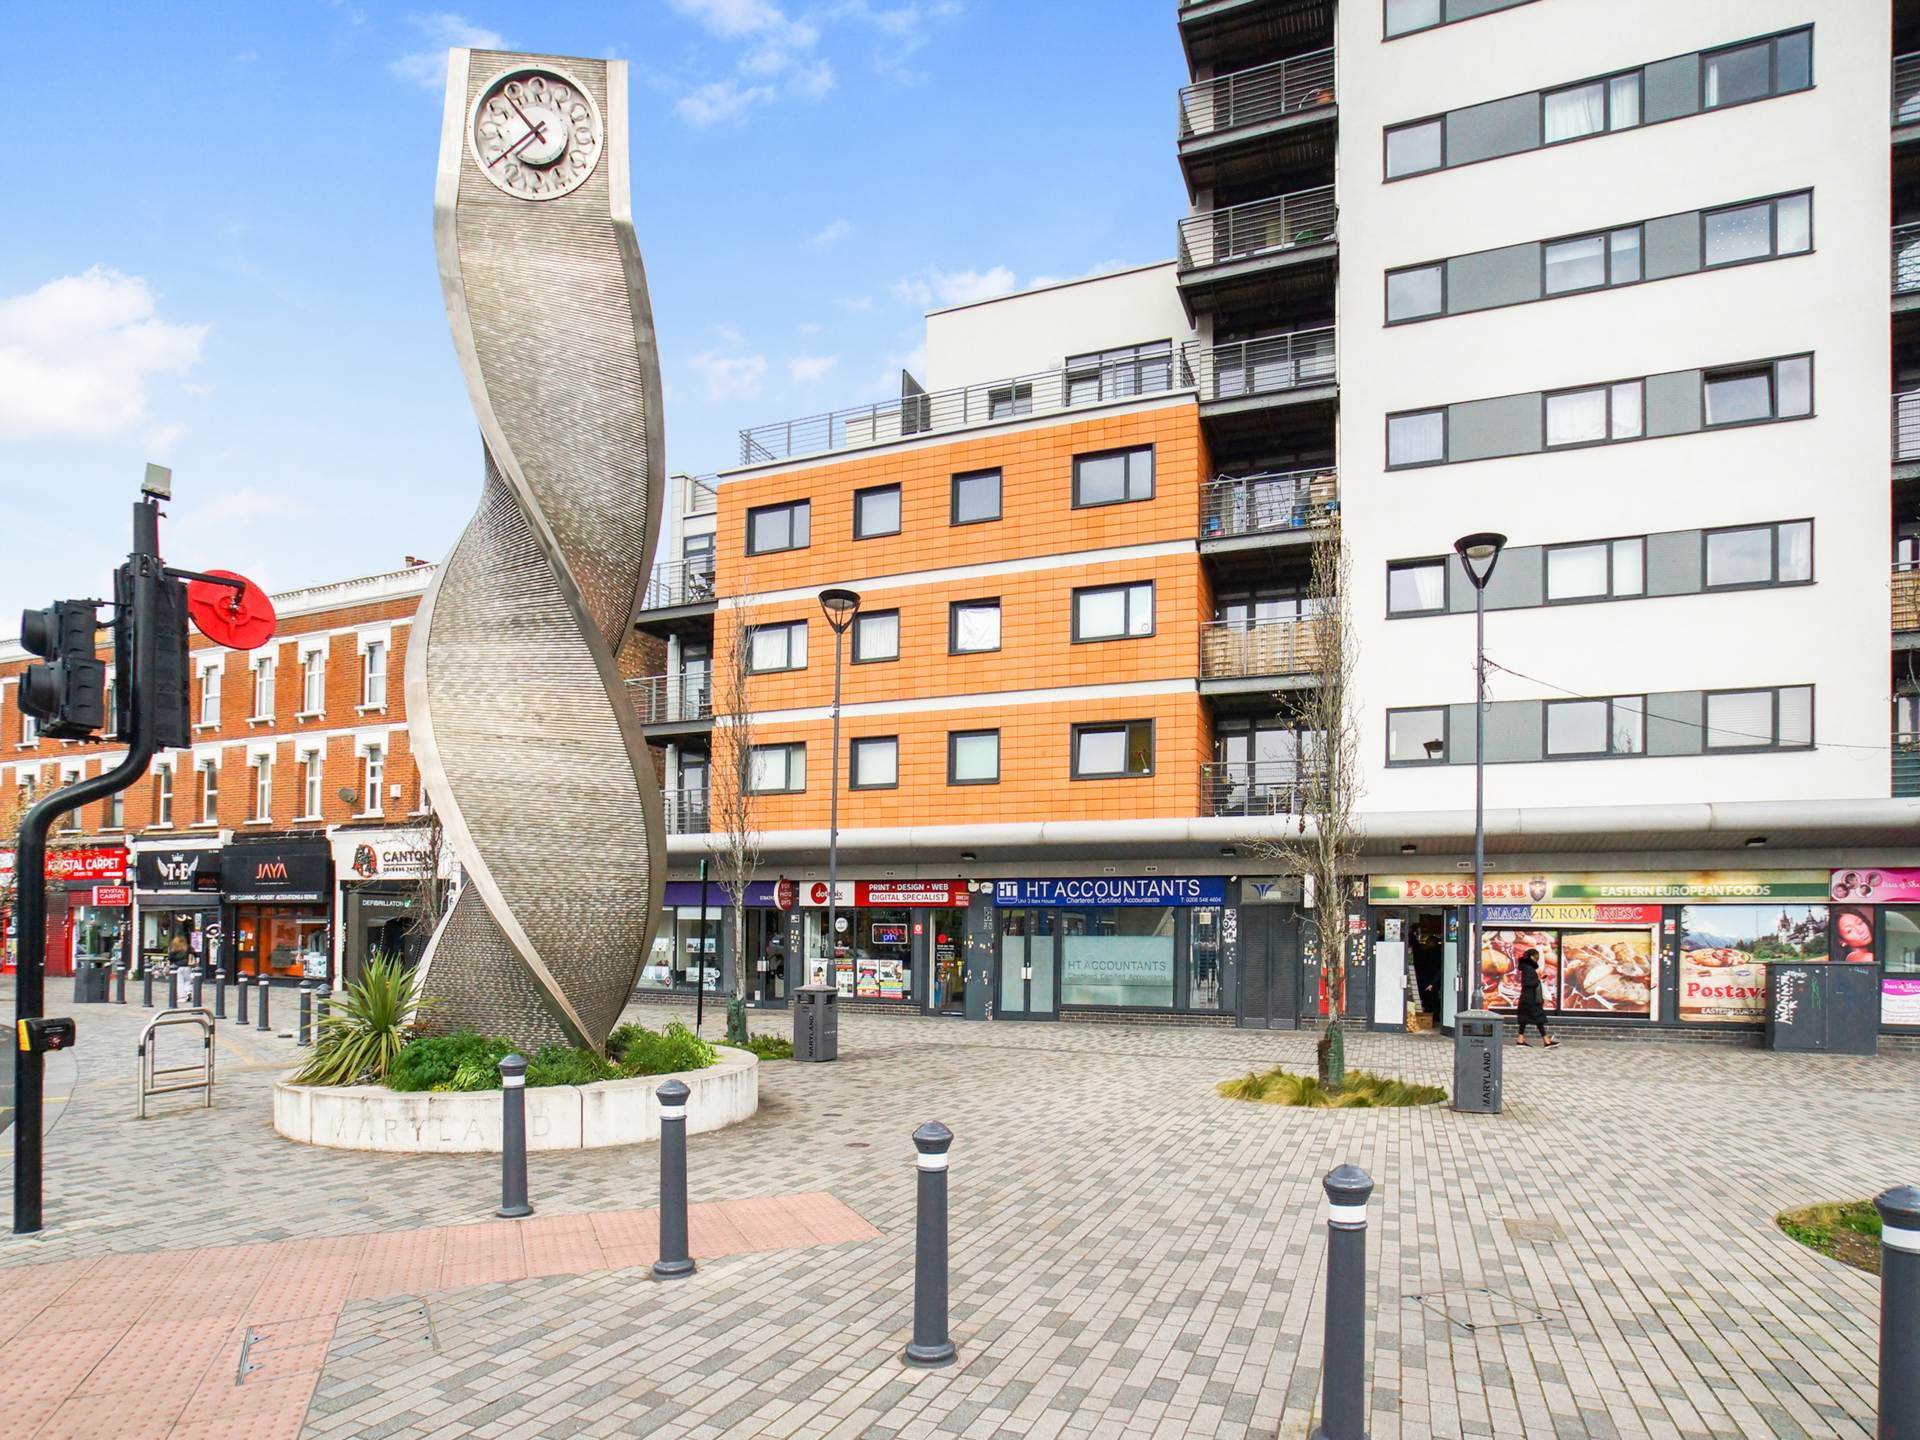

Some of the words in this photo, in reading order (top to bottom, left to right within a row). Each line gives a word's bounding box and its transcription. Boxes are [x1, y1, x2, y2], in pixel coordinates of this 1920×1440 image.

[86, 857, 119, 869] CARPET
[897, 883, 924, 891] DESIGN
[931, 883, 949, 891] WEB
[1026, 881, 1051, 897] HT
[1054, 879, 1200, 897] ACCOUNTANTS
[1600, 886, 1654, 896] EASTERN
[1655, 885, 1724, 896] EUROPEAN
[1726, 885, 1770, 896] FOODS
[871, 893, 899, 901] DIGITAL
[902, 893, 945, 901] SPECIALIST
[1486, 907, 1555, 920] MAGAZIN
[1559, 907, 1643, 920] ROMANESC
[1068, 961, 1081, 970] HT
[1084, 961, 1167, 971] ACCOUNTANTS
[1483, 1052, 1491, 1107] MARYLAND
[330, 1115, 549, 1141] MARYLAD
